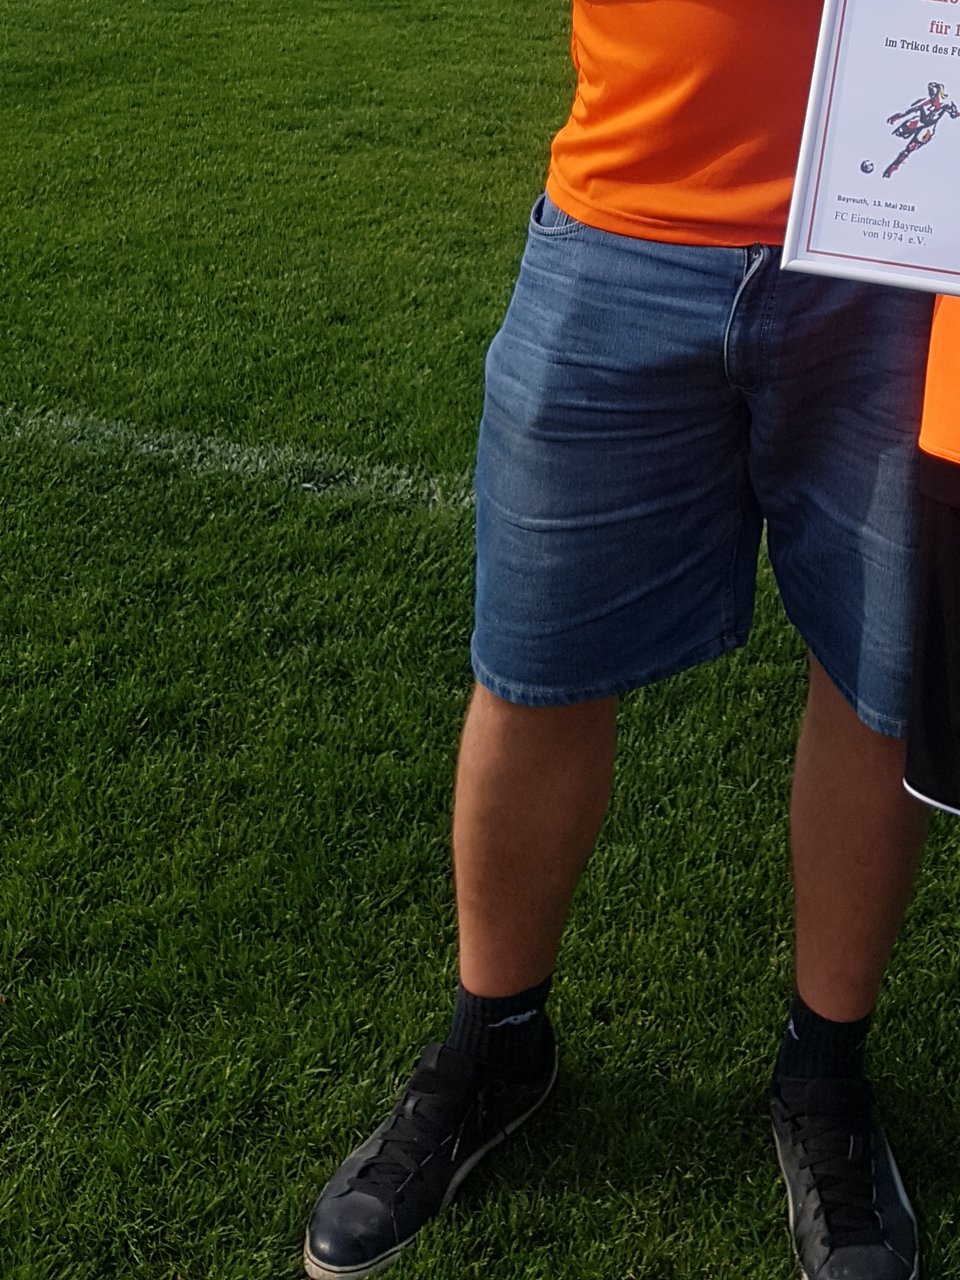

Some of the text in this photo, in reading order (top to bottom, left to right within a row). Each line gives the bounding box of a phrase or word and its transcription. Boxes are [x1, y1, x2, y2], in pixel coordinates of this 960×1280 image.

[929, 20, 951, 35] für
[885, 37, 897, 47] im
[900, 39, 930, 53] Trikot
[932, 44, 949, 56] des
[837, 195, 869, 206] Bayreuth,
[885, 201, 898, 210] Mai
[899, 203, 915, 212] 2018
[835, 211, 933, 234] FC Eintracht Bayreuth
[863, 230, 926, 246] von 1974 e.V.
